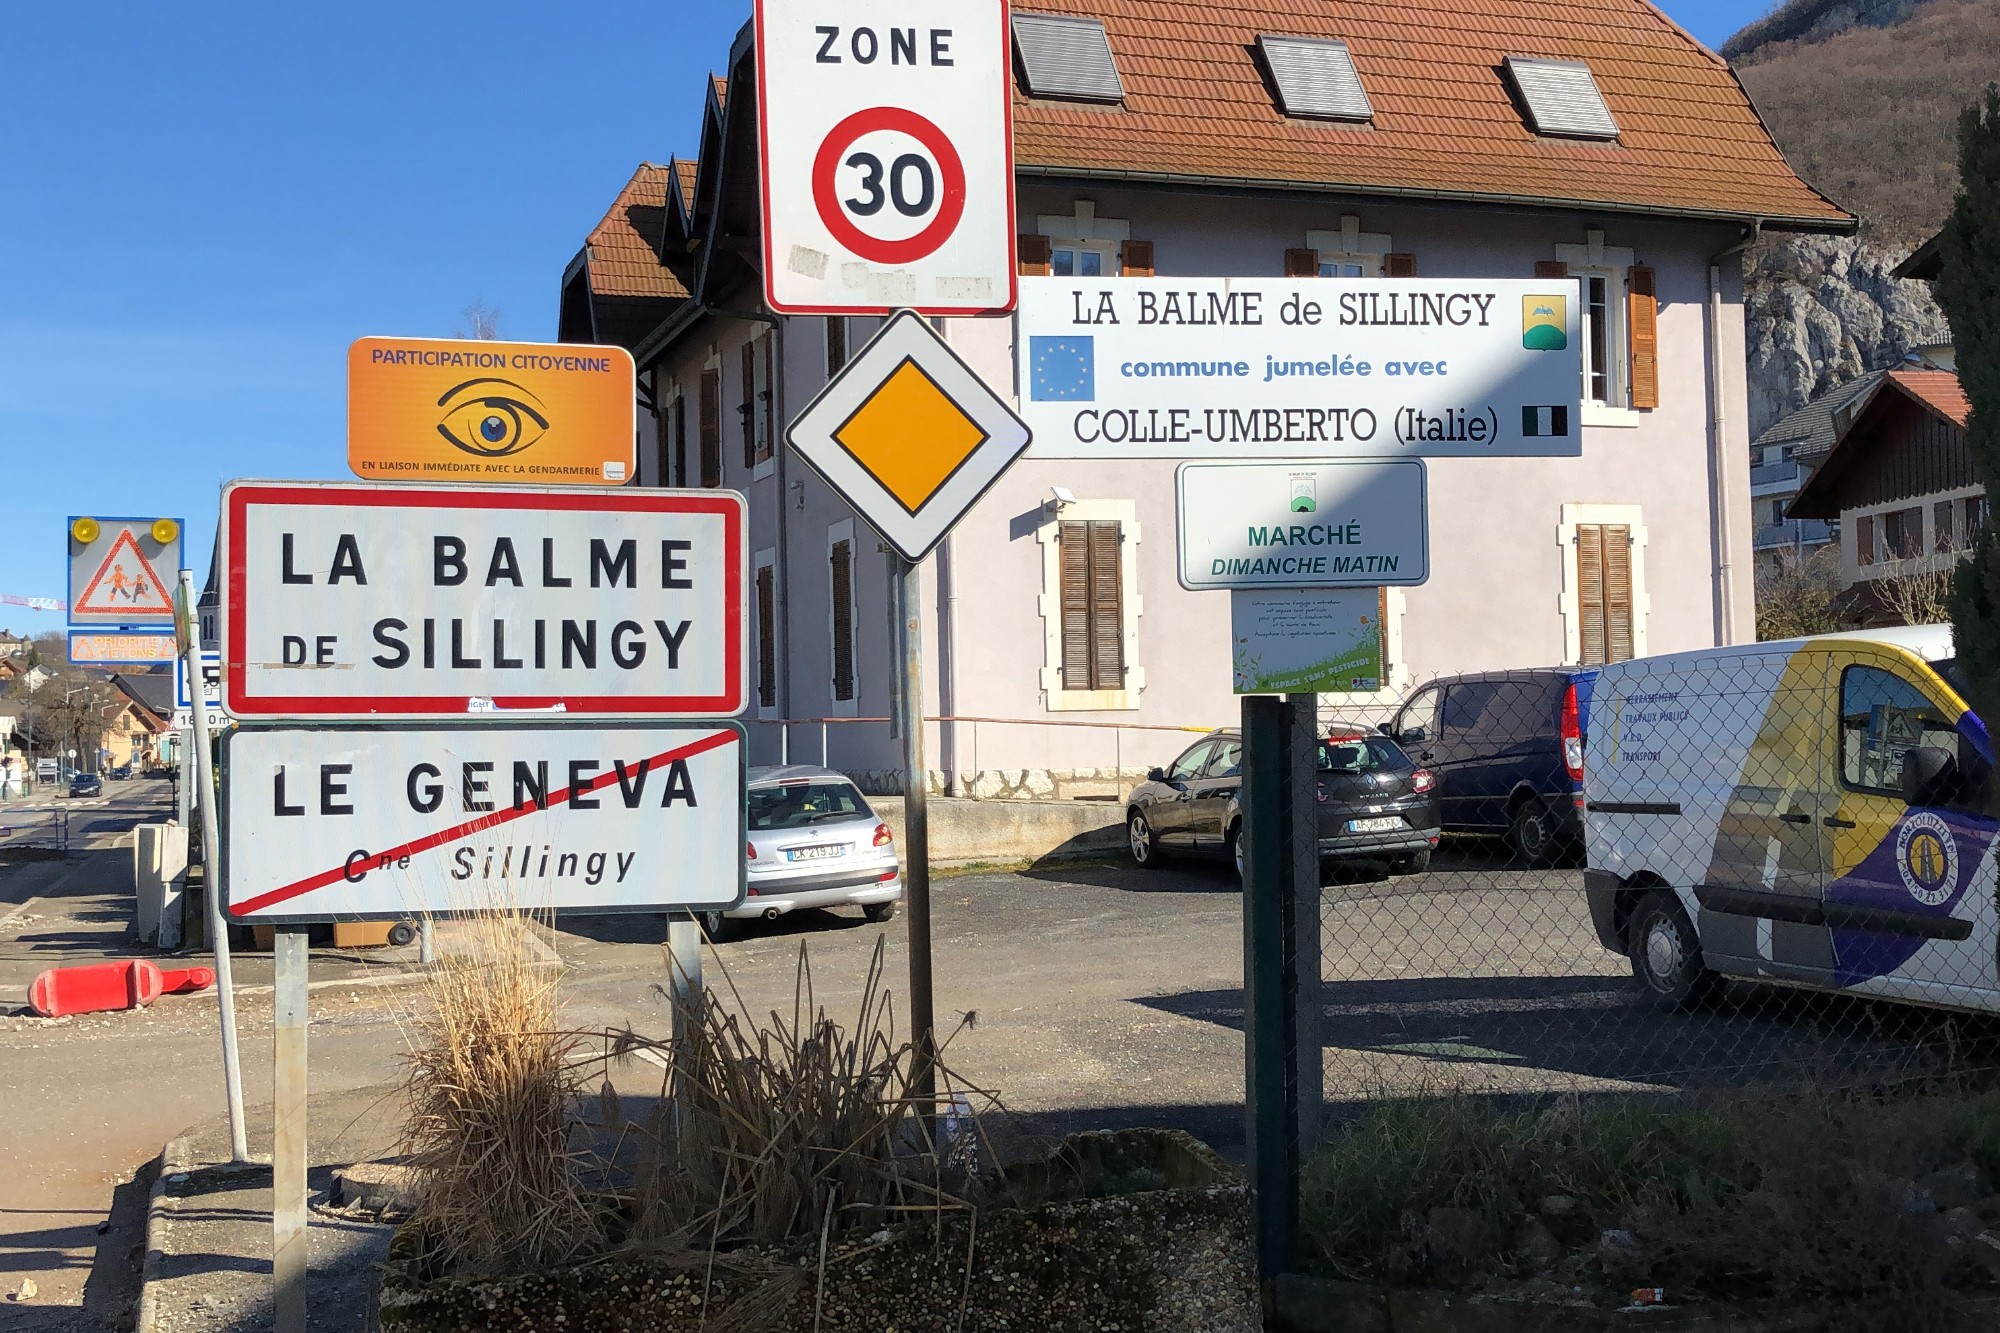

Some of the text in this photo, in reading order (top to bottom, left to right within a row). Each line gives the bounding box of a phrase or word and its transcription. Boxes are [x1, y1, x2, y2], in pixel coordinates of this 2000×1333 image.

[815, 26, 955, 67] ZONE
[844, 151, 936, 218] 30
[1071, 291, 1496, 328] LA BALME de SILLINGY
[371, 348, 611, 373] PARTICIPATION CITOYENNE
[1120, 353, 1448, 383] commune jumelée avec
[1073, 405, 1499, 446] COLLE-UMBERTO (Italie)
[361, 461, 376, 470] EN
[379, 461, 420, 471] LIAISON
[423, 460, 481, 473] IMMÉDIATE
[484, 464, 510, 474] AVEC
[513, 465, 527, 475] LA
[528, 465, 600, 476] GENDARMERIE
[1247, 518, 1362, 547] MARCHÉ
[281, 532, 693, 590] LA BALME
[1210, 555, 1399, 576] DIMANCHE MATIN
[282, 617, 693, 670] DE SILLINGY
[1270, 677, 1302, 690] ESPACE
[1327, 657, 1371, 676] PESTICIDE
[1625, 710, 1689, 723] TRAVAUX PUBLICS
[1622, 751, 1661, 762] TRANSPORT
[273, 758, 699, 816] LE GENEVA
[450, 844, 637, 886] Sillingy
